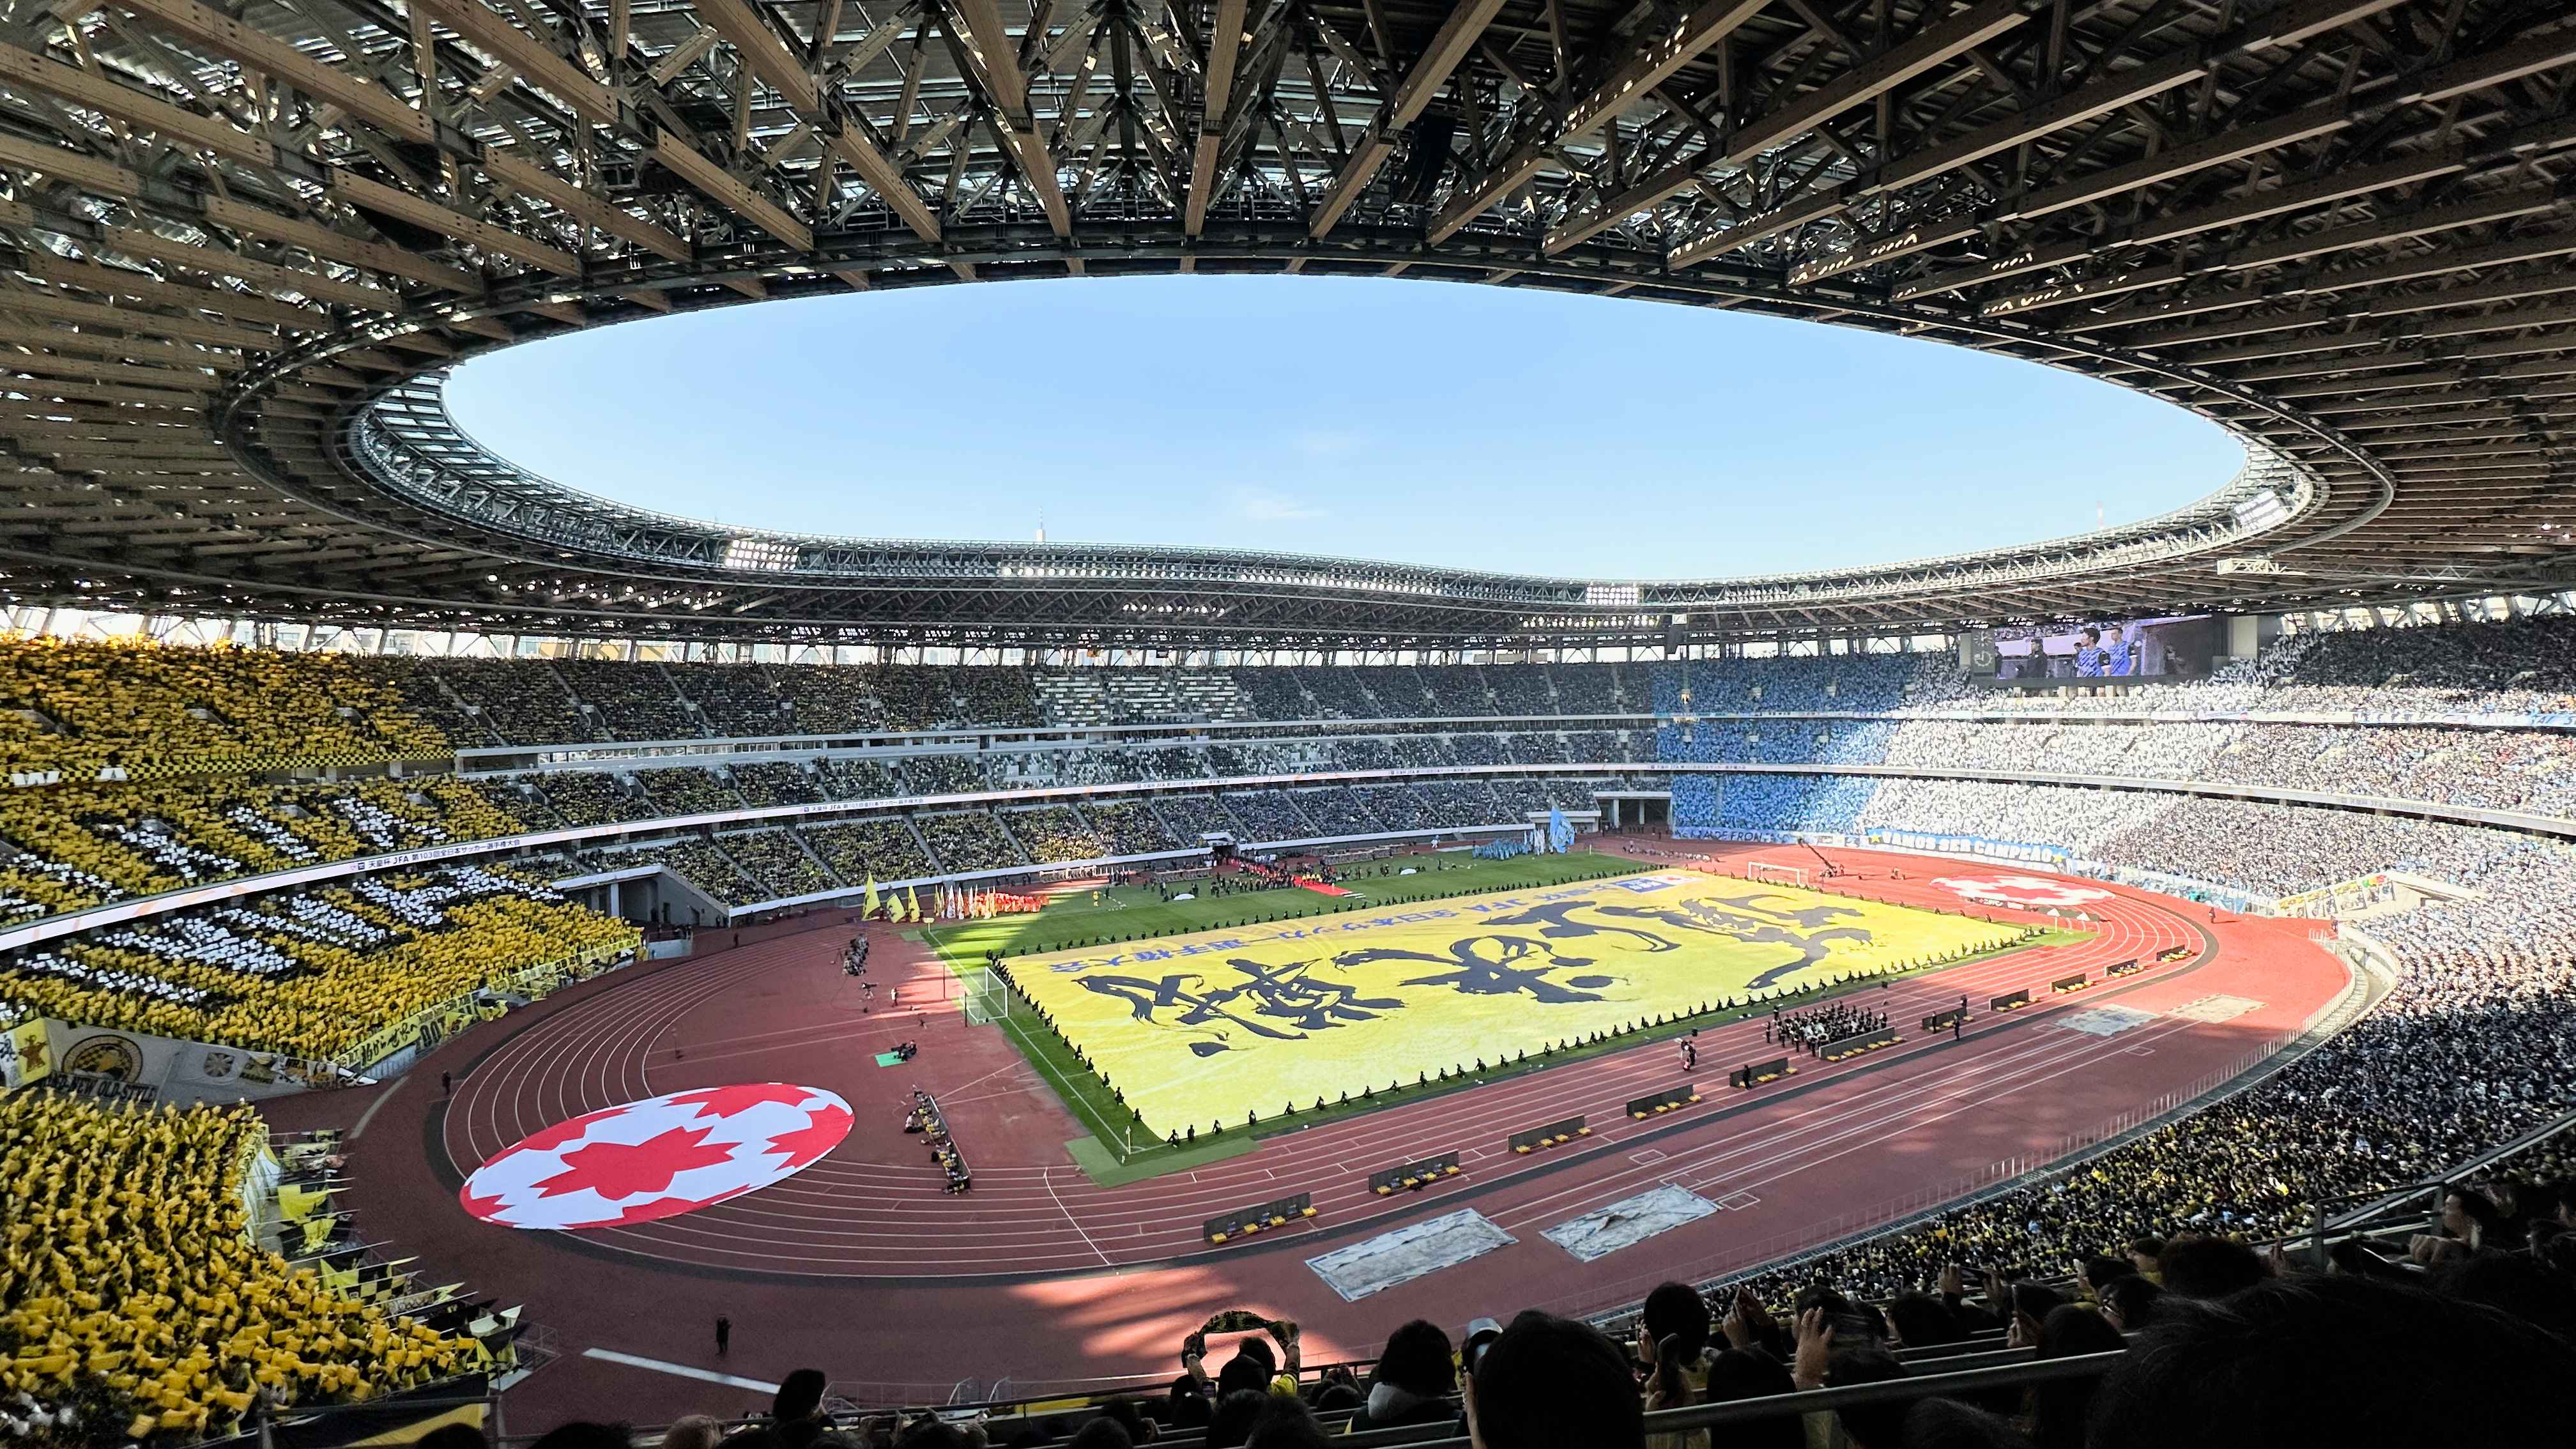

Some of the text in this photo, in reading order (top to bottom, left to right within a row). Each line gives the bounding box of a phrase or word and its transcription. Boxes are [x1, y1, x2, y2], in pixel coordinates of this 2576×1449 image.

[11, 767, 128, 786] W A
[1881, 831, 1936, 850] VAMOS
[392, 855, 410, 865] JFA
[1462, 898, 1528, 914] JFA
